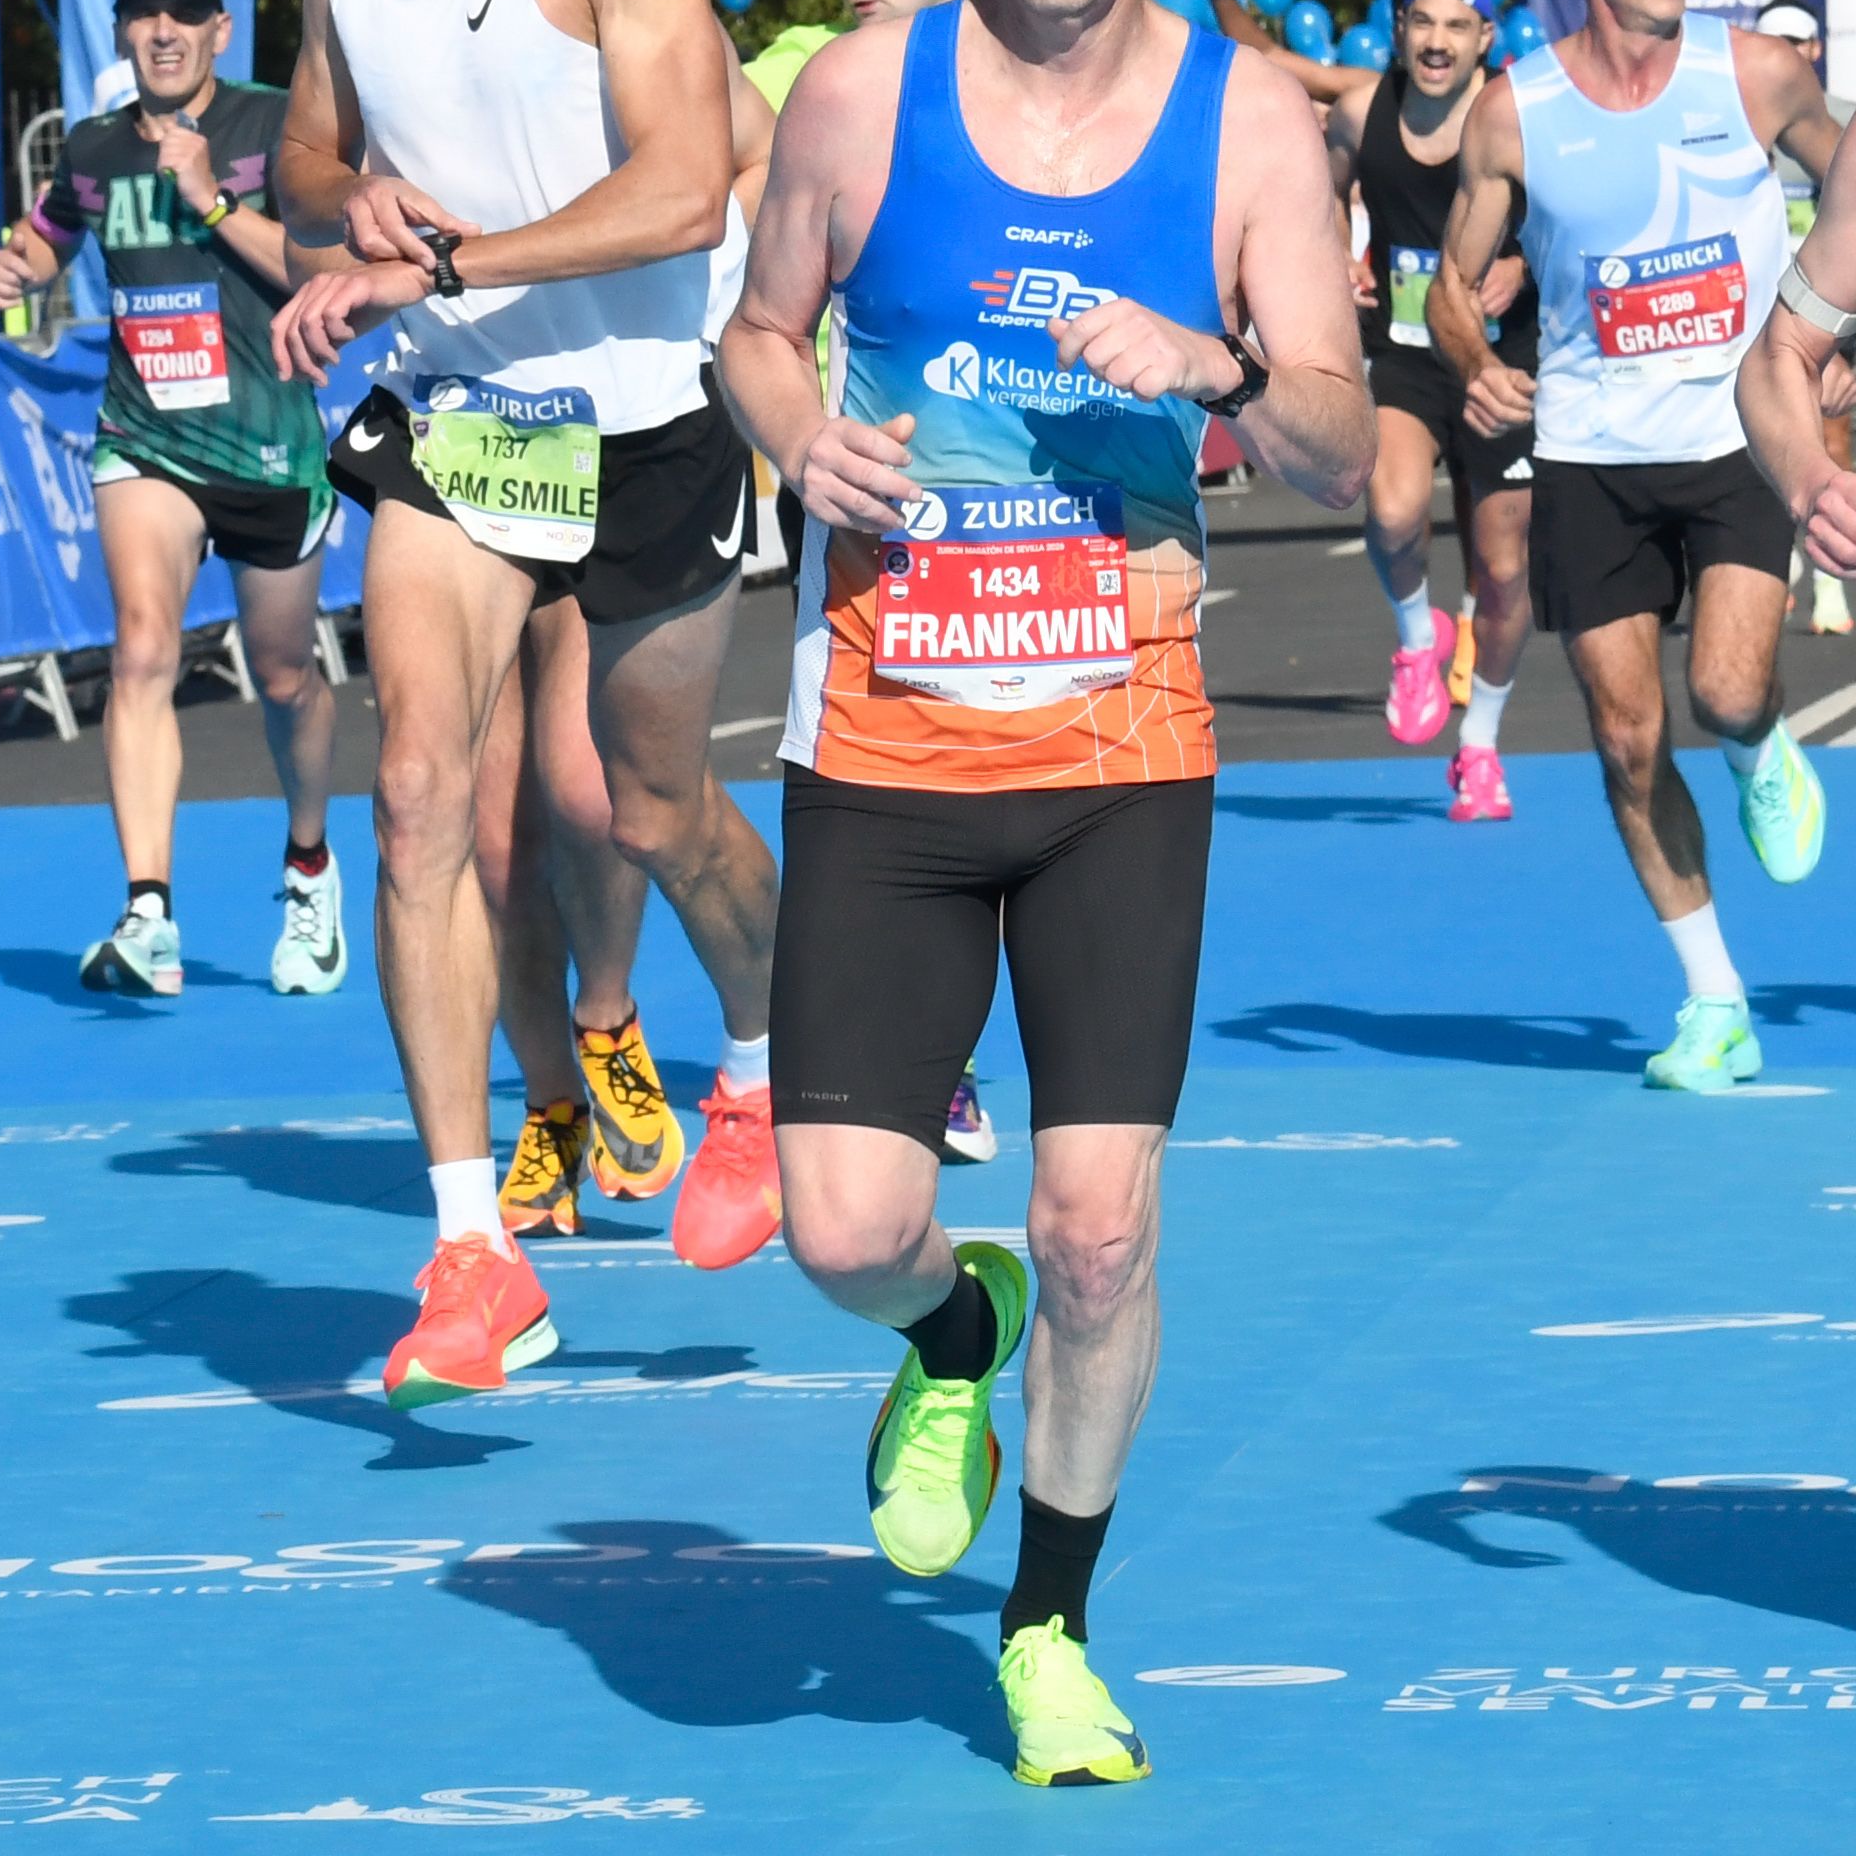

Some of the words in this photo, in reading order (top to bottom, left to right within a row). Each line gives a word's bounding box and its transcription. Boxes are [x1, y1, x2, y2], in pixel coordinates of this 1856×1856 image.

[1005, 226, 1075, 246] CRAFT
[1639, 242, 1724, 279] ZURICH
[132, 291, 202, 312] ZURICH
[1648, 291, 1696, 316] 1289
[978, 311, 1046, 328] Lopers
[1615, 308, 1736, 353] GRACIET
[987, 389, 1125, 420] verzekeringen
[479, 435, 530, 460] 1737
[499, 478, 596, 519] SMILE
[962, 496, 1095, 530] ZURICH
[969, 565, 1041, 598] 1434
[882, 605, 1127, 659] FRANKWIN
[801, 1090, 850, 1103] EVADIET
